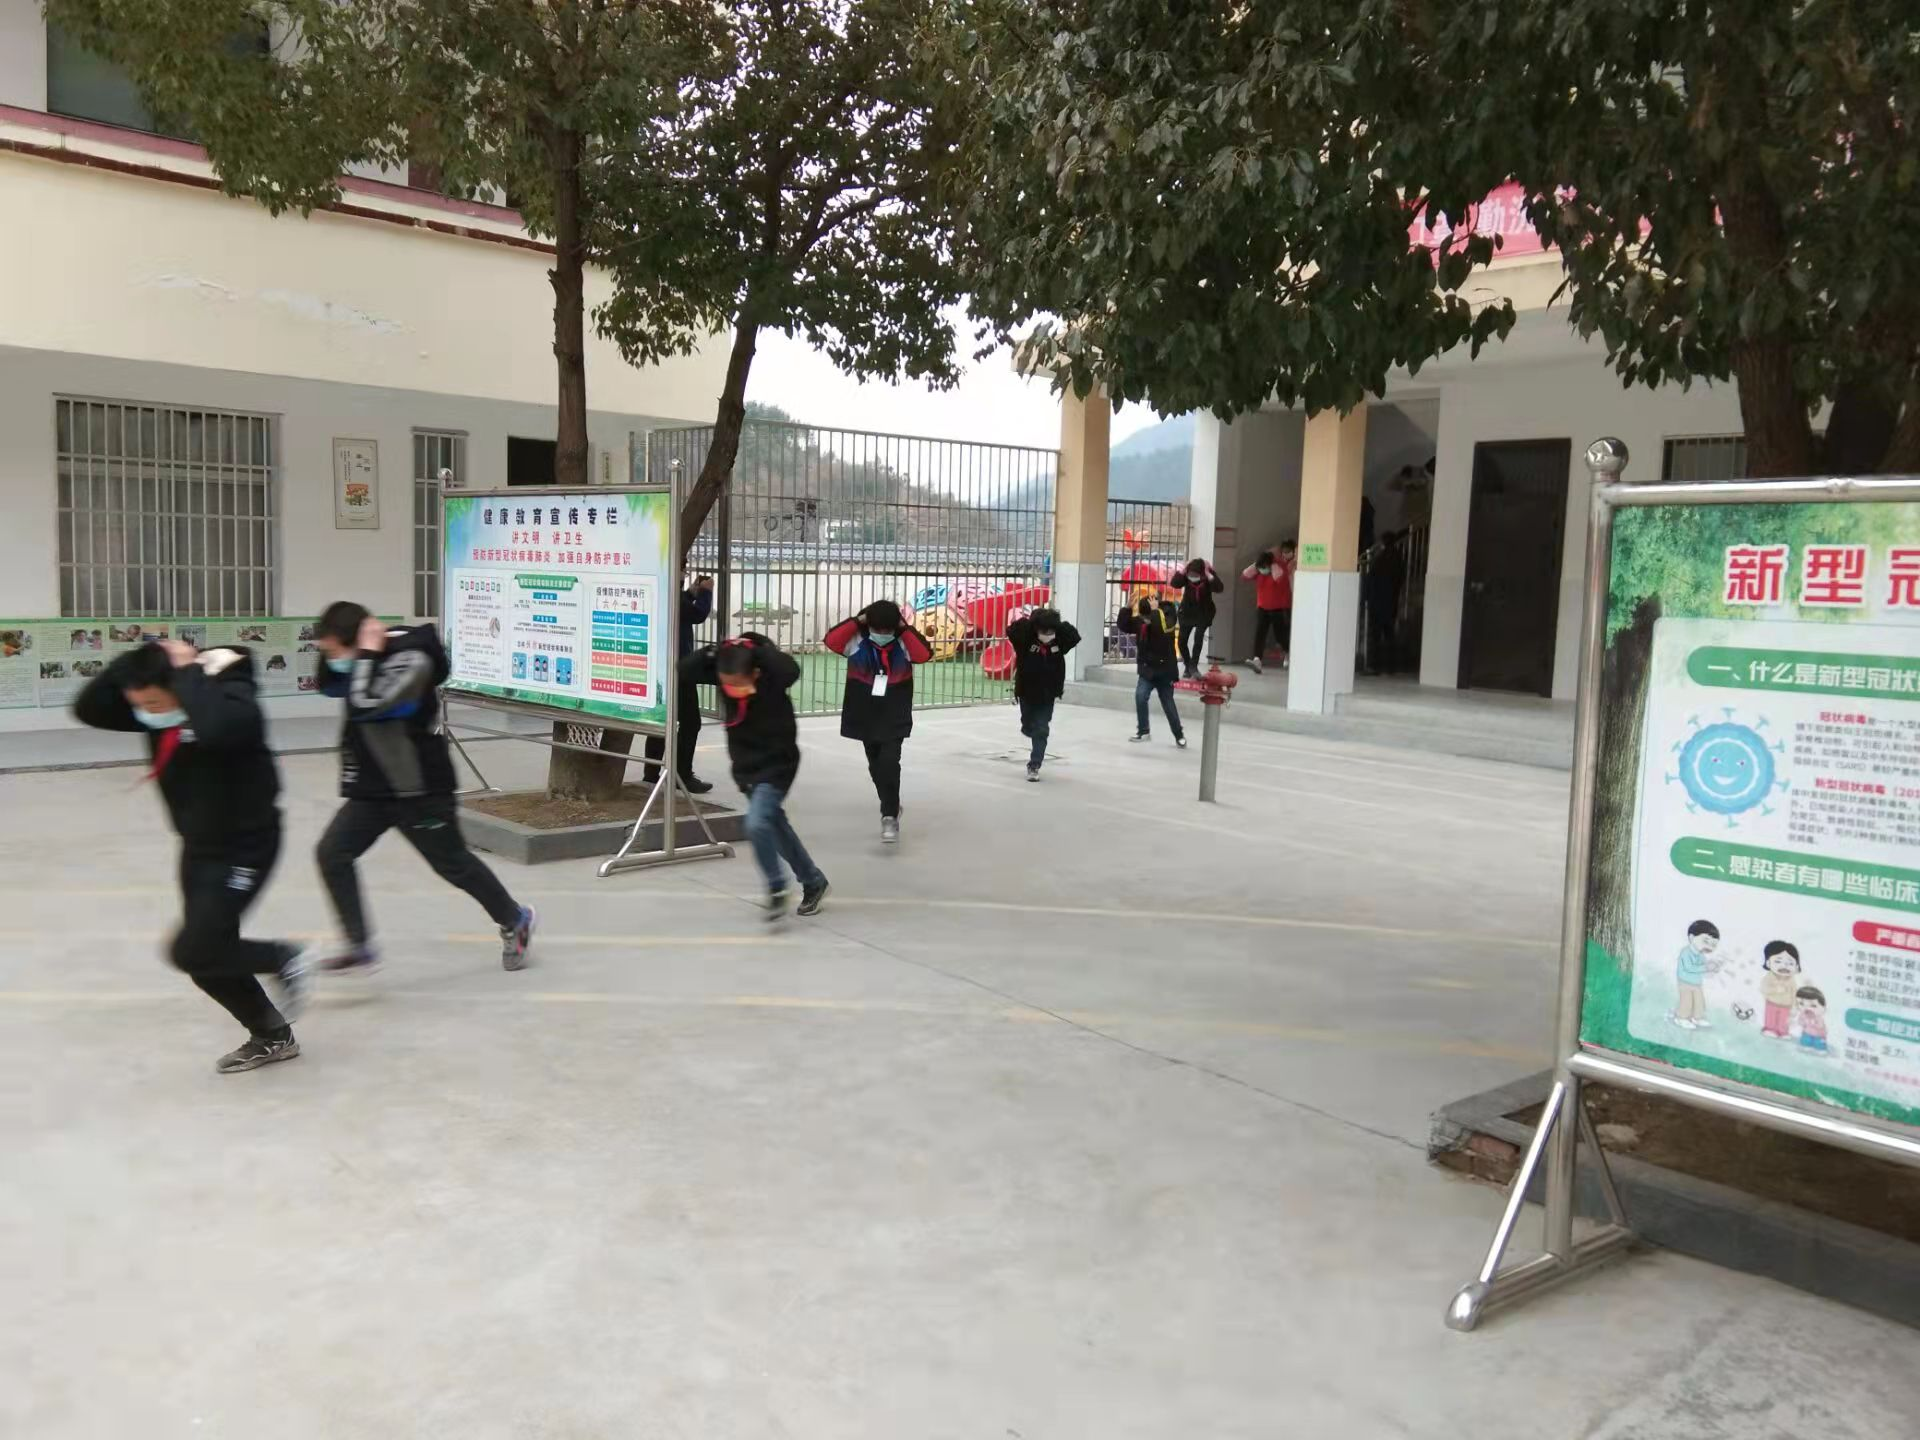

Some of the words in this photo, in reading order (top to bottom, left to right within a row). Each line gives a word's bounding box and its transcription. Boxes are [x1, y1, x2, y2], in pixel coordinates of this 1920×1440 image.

[483, 507, 618, 526] 健康教育宣传专栏
[511, 531, 540, 545] 讲文明
[552, 531, 583, 546] 讲卫生
[558, 552, 631, 566] 加强自身防护意识
[1692, 849, 1920, 904] 二、感染者有哪些临床
